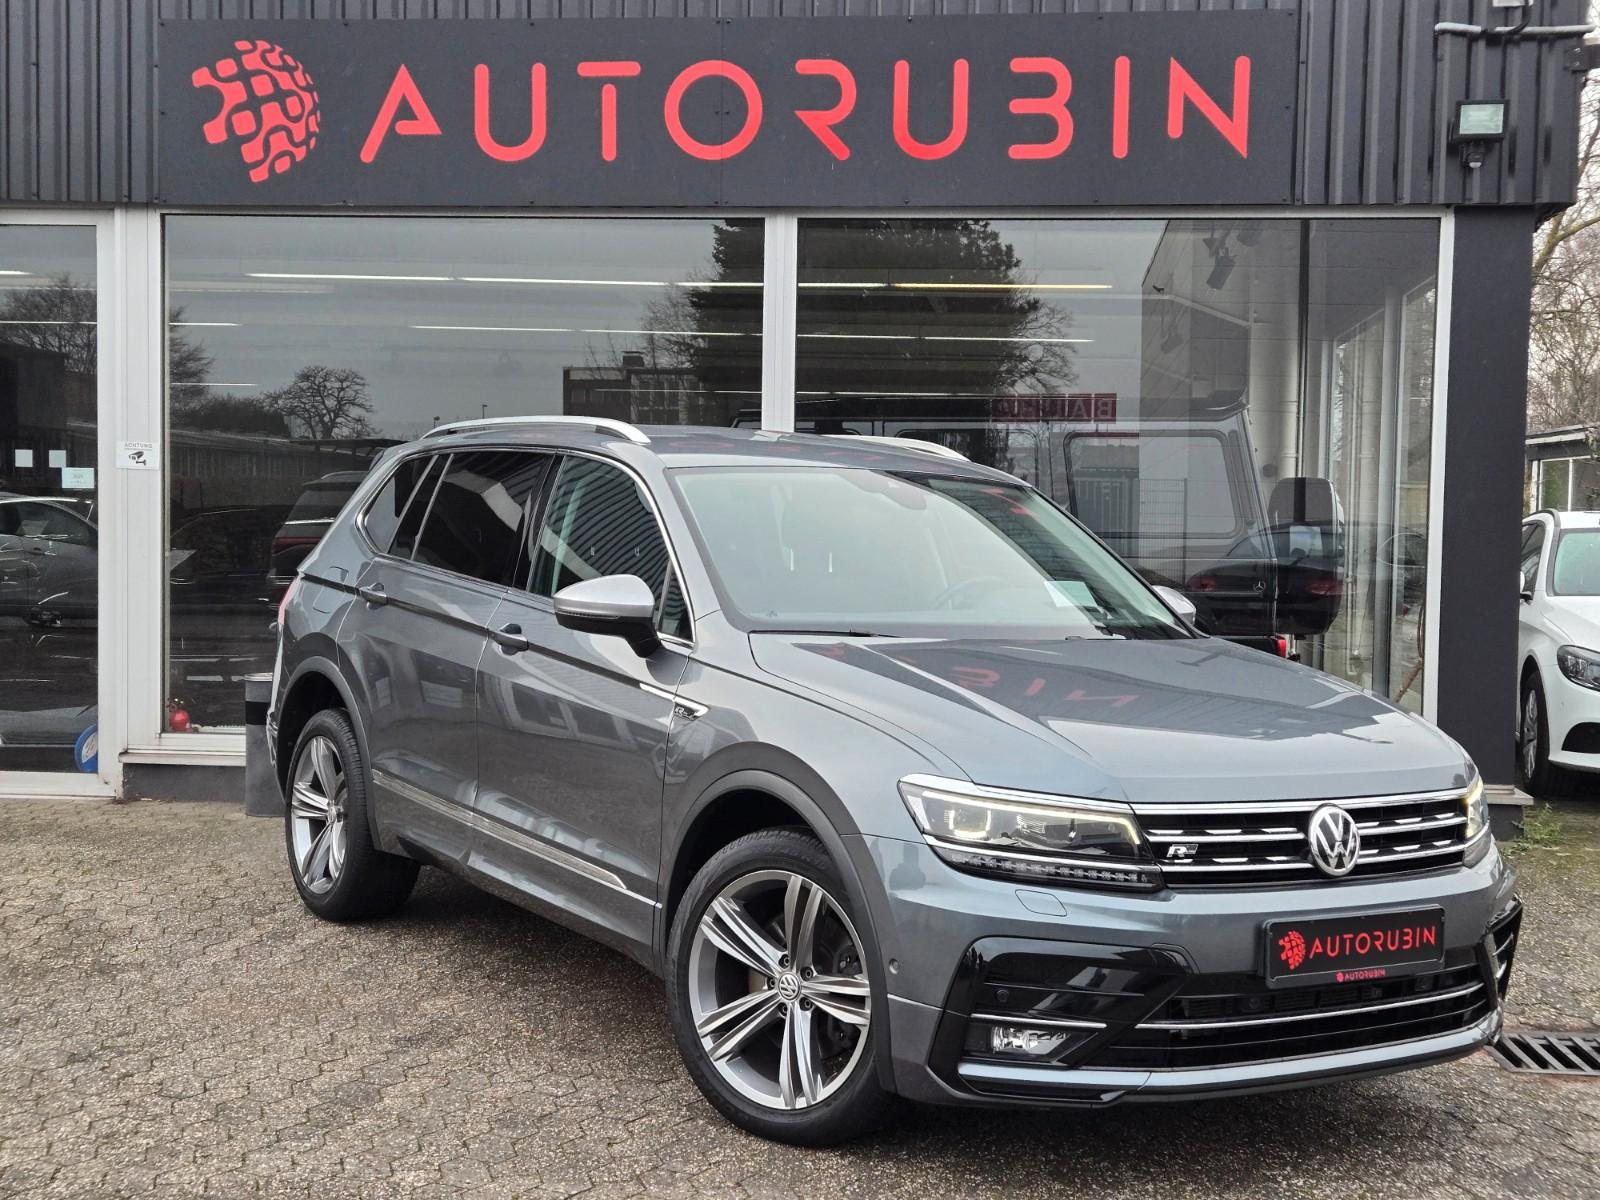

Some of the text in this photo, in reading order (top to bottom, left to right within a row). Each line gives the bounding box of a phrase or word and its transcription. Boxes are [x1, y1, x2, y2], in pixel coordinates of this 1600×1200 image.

[359, 56, 1252, 163] AUTORUBIN
[1309, 926, 1436, 960] AUTORUBIN
[1345, 968, 1386, 981] AUTORUBIN
